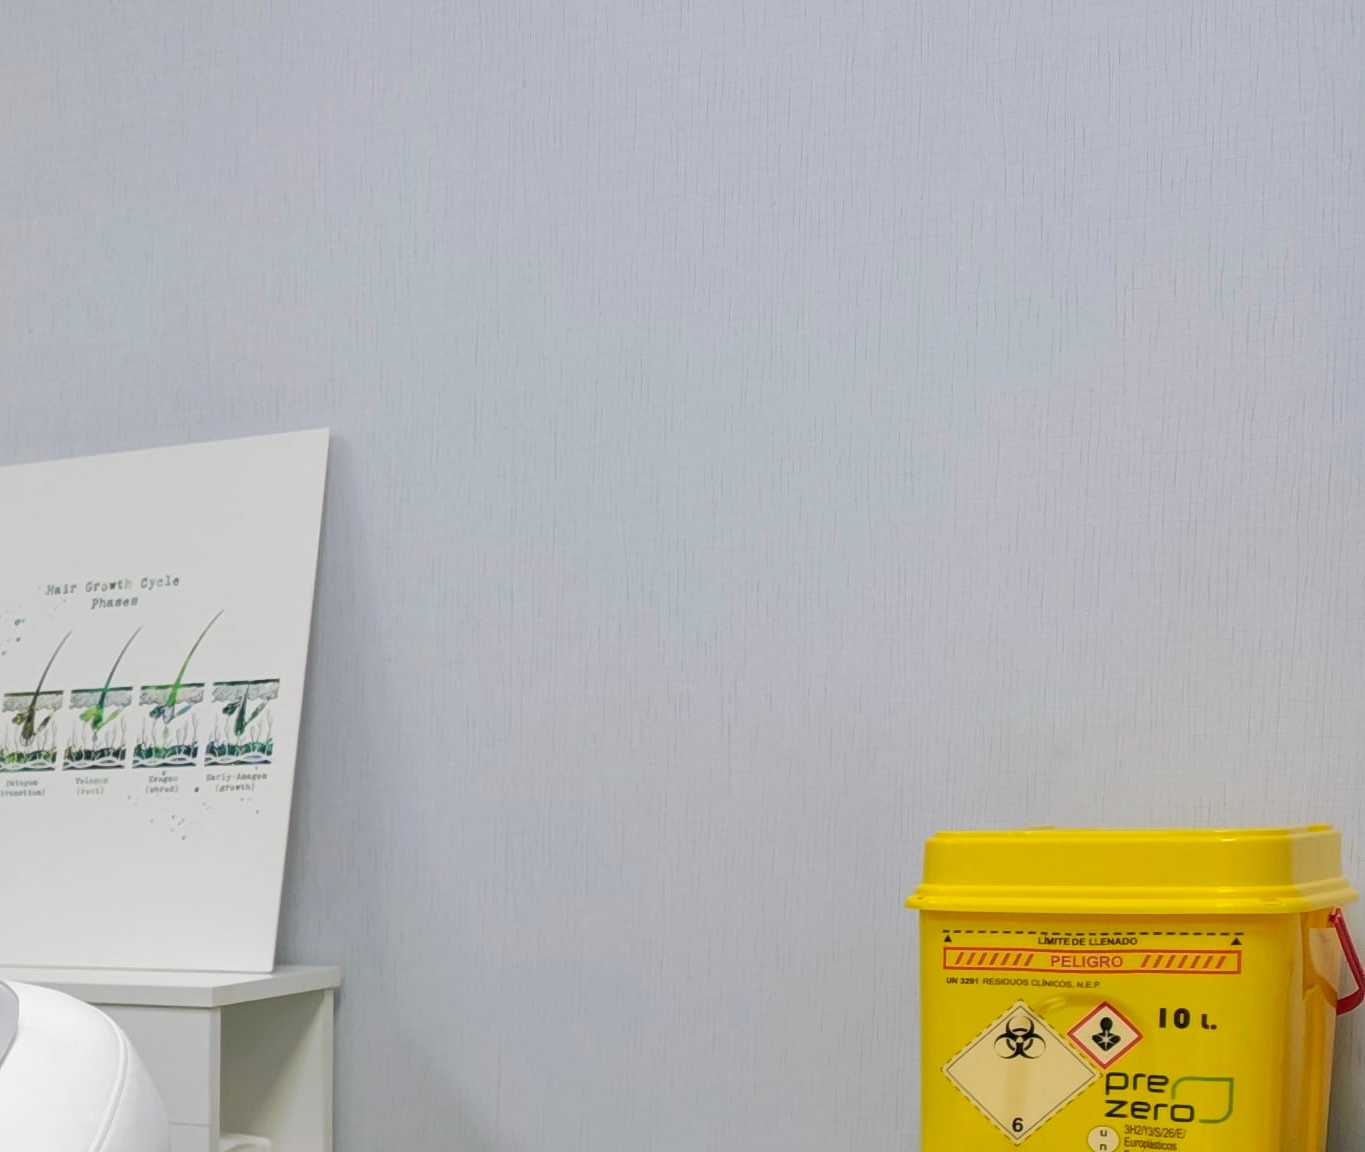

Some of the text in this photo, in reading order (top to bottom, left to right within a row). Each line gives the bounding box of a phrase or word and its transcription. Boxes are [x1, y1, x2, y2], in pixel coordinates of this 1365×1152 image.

[45, 575, 180, 596] Hair Growth Cycle
[91, 597, 138, 610] Phases
[1037, 936, 1138, 946] LÍMITE DE LLENADO
[1050, 955, 1124, 968] PELIGRO
[946, 977, 958, 985] UN
[960, 977, 979, 985] 3291
[983, 978, 1029, 986] RESIDUOS
[1159, 1008, 1190, 1029] 10
[1105, 1072, 1169, 1095] pre
[1105, 1100, 1194, 1122] zero
[1012, 1117, 1024, 1133] 6
